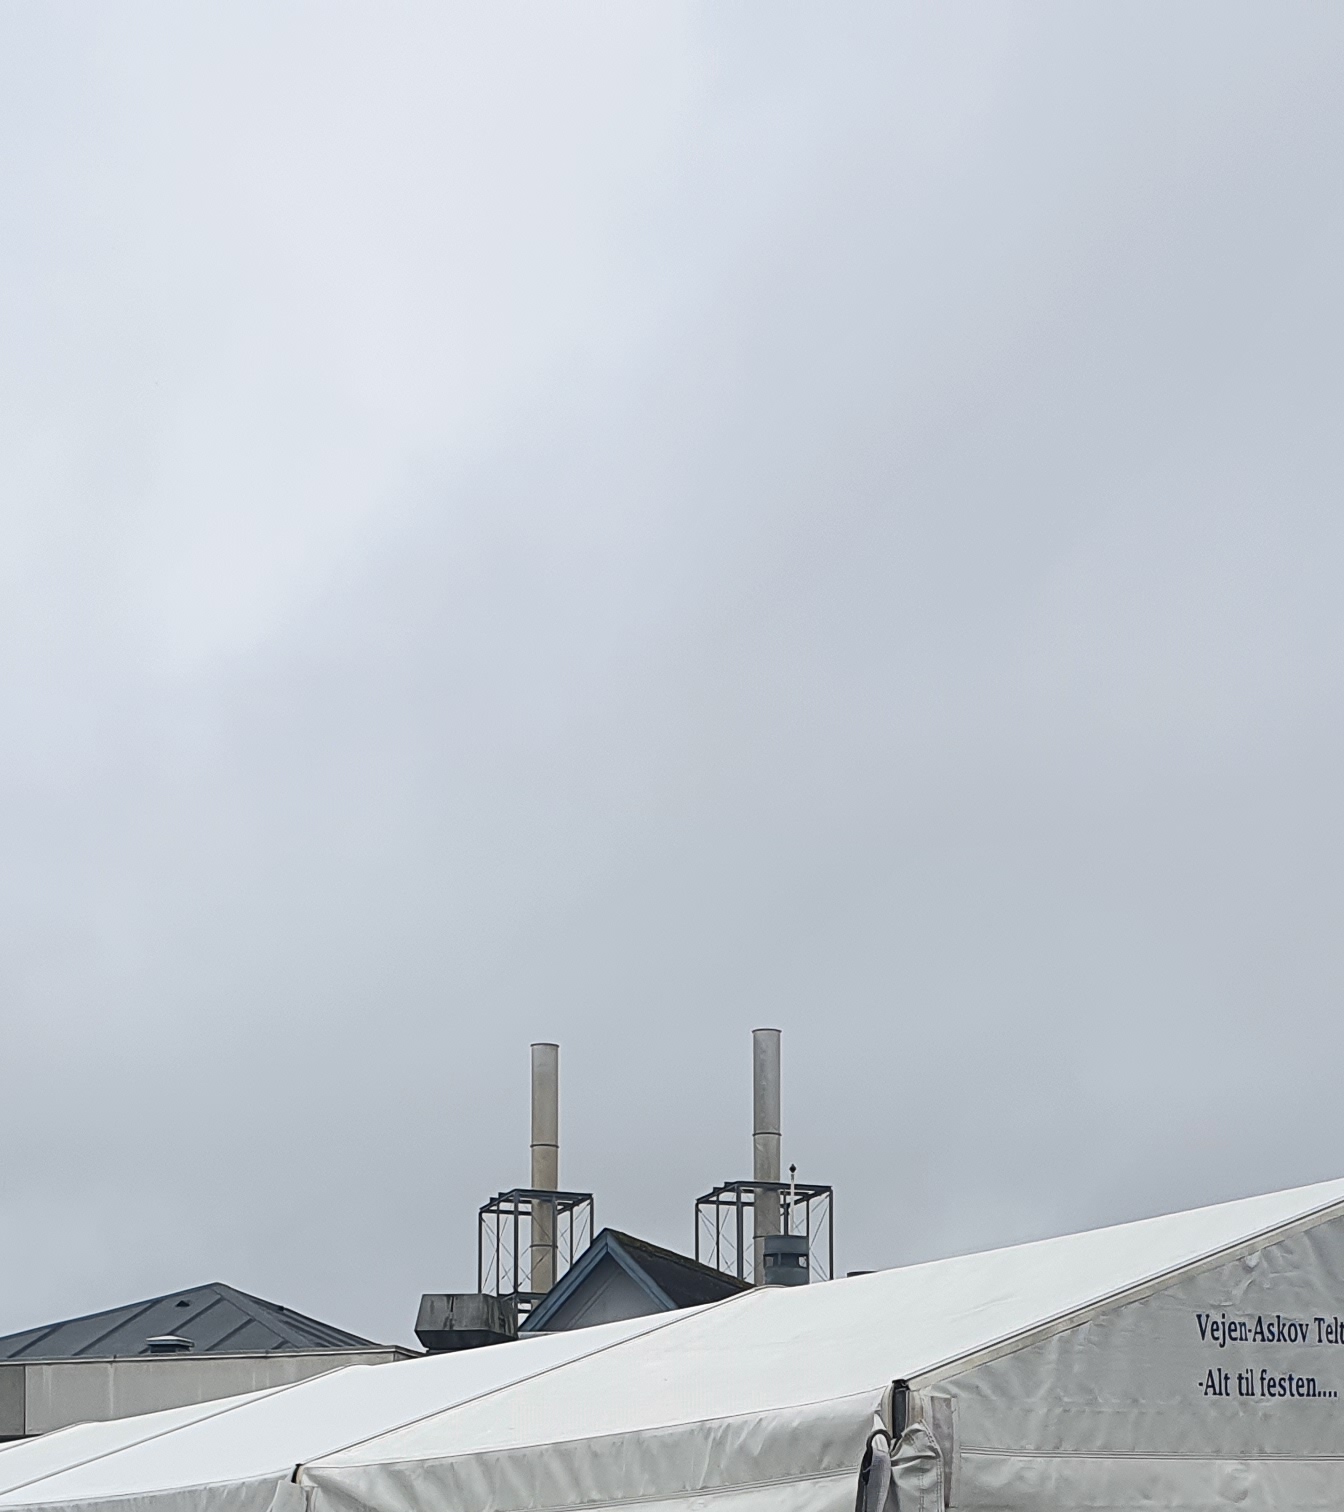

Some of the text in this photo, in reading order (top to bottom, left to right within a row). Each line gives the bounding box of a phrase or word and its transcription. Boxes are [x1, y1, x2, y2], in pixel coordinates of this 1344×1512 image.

[1196, 1313, 1309, 1348] Vejen-Askov
[1198, 1368, 1230, 1397] -Alt
[1237, 1368, 1254, 1396] til
